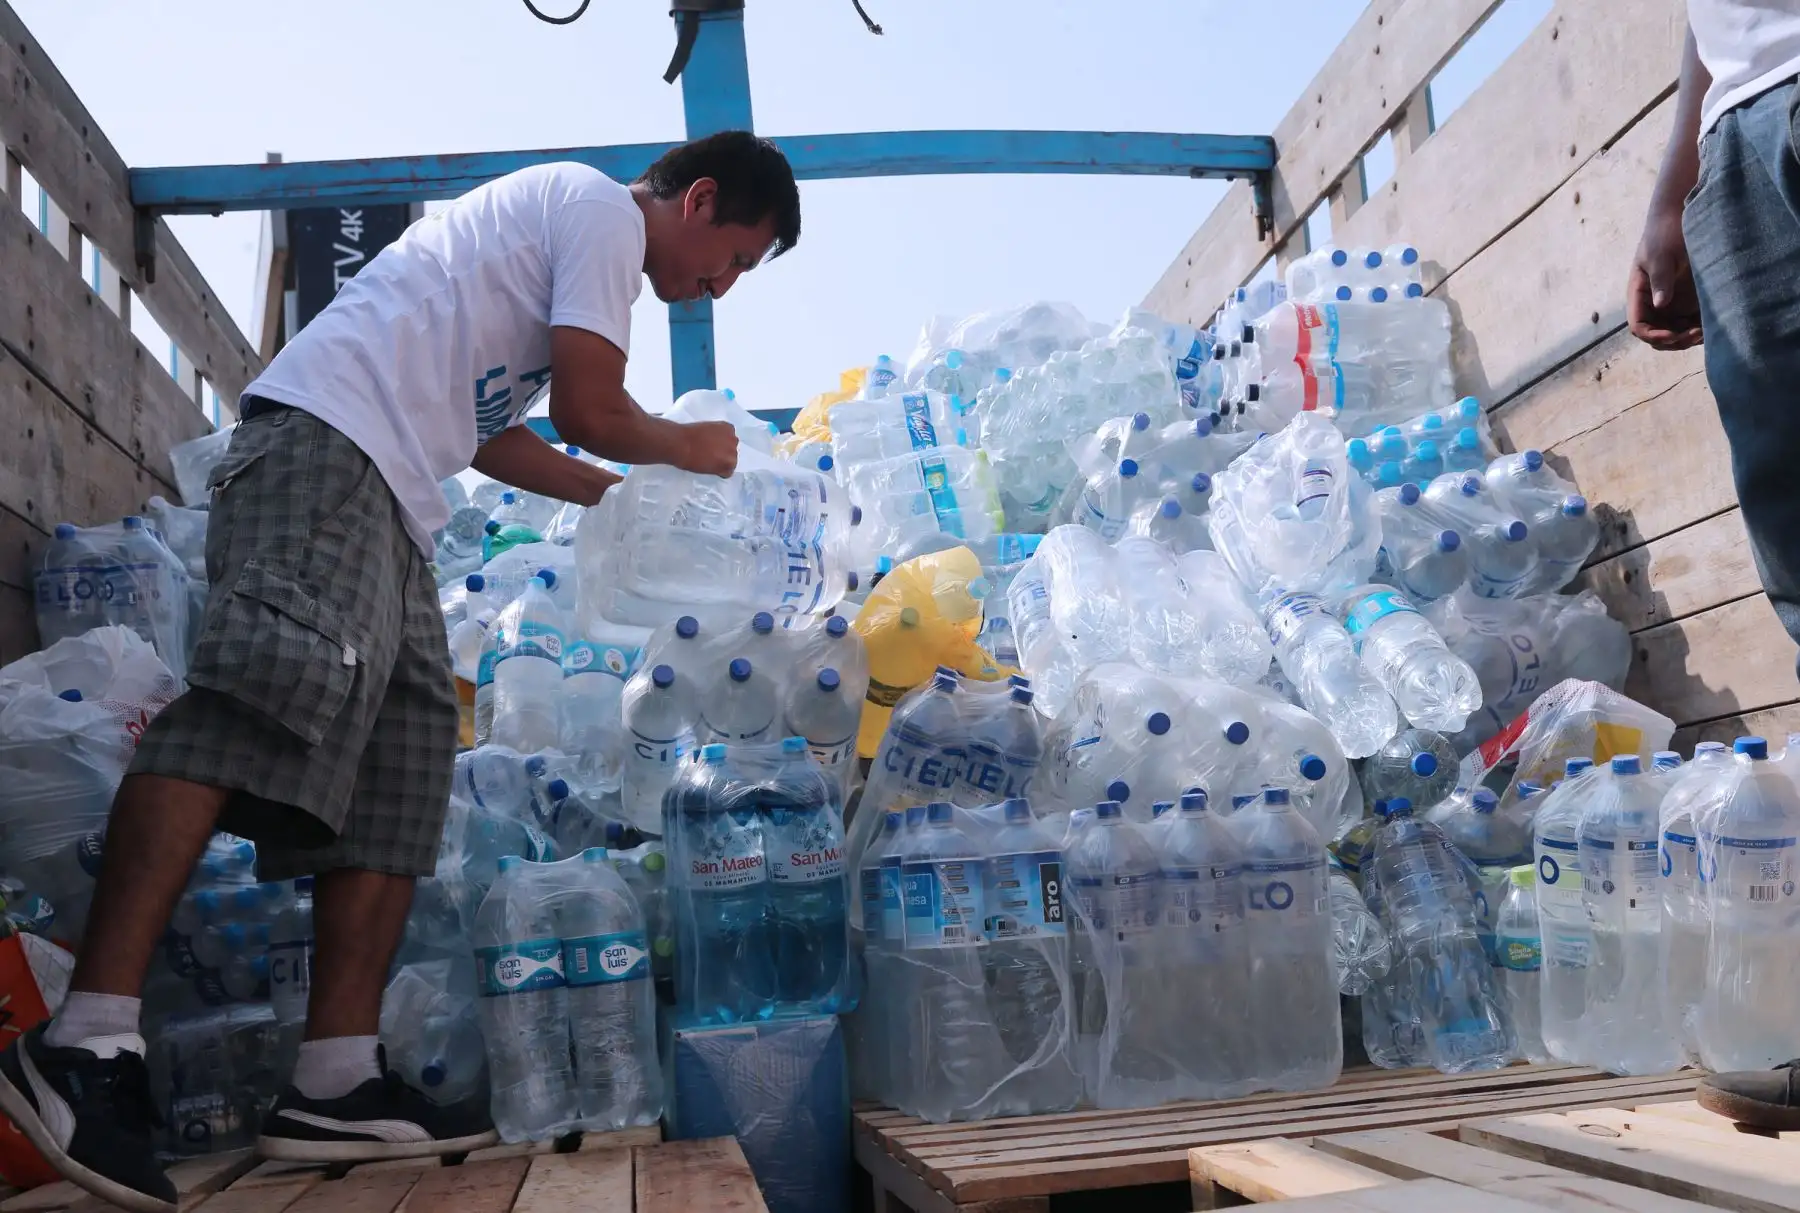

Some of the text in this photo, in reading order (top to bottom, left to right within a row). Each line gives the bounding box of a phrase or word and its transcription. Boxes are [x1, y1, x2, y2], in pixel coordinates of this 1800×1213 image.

[333, 208, 365, 292] TV 4K
[692, 860, 719, 875] San
[722, 855, 763, 873] Mateo
[791, 852, 821, 867] San
[1046, 880, 1061, 922] aro
[605, 945, 627, 958] san
[499, 958, 521, 970] san
[607, 956, 629, 969] luis
